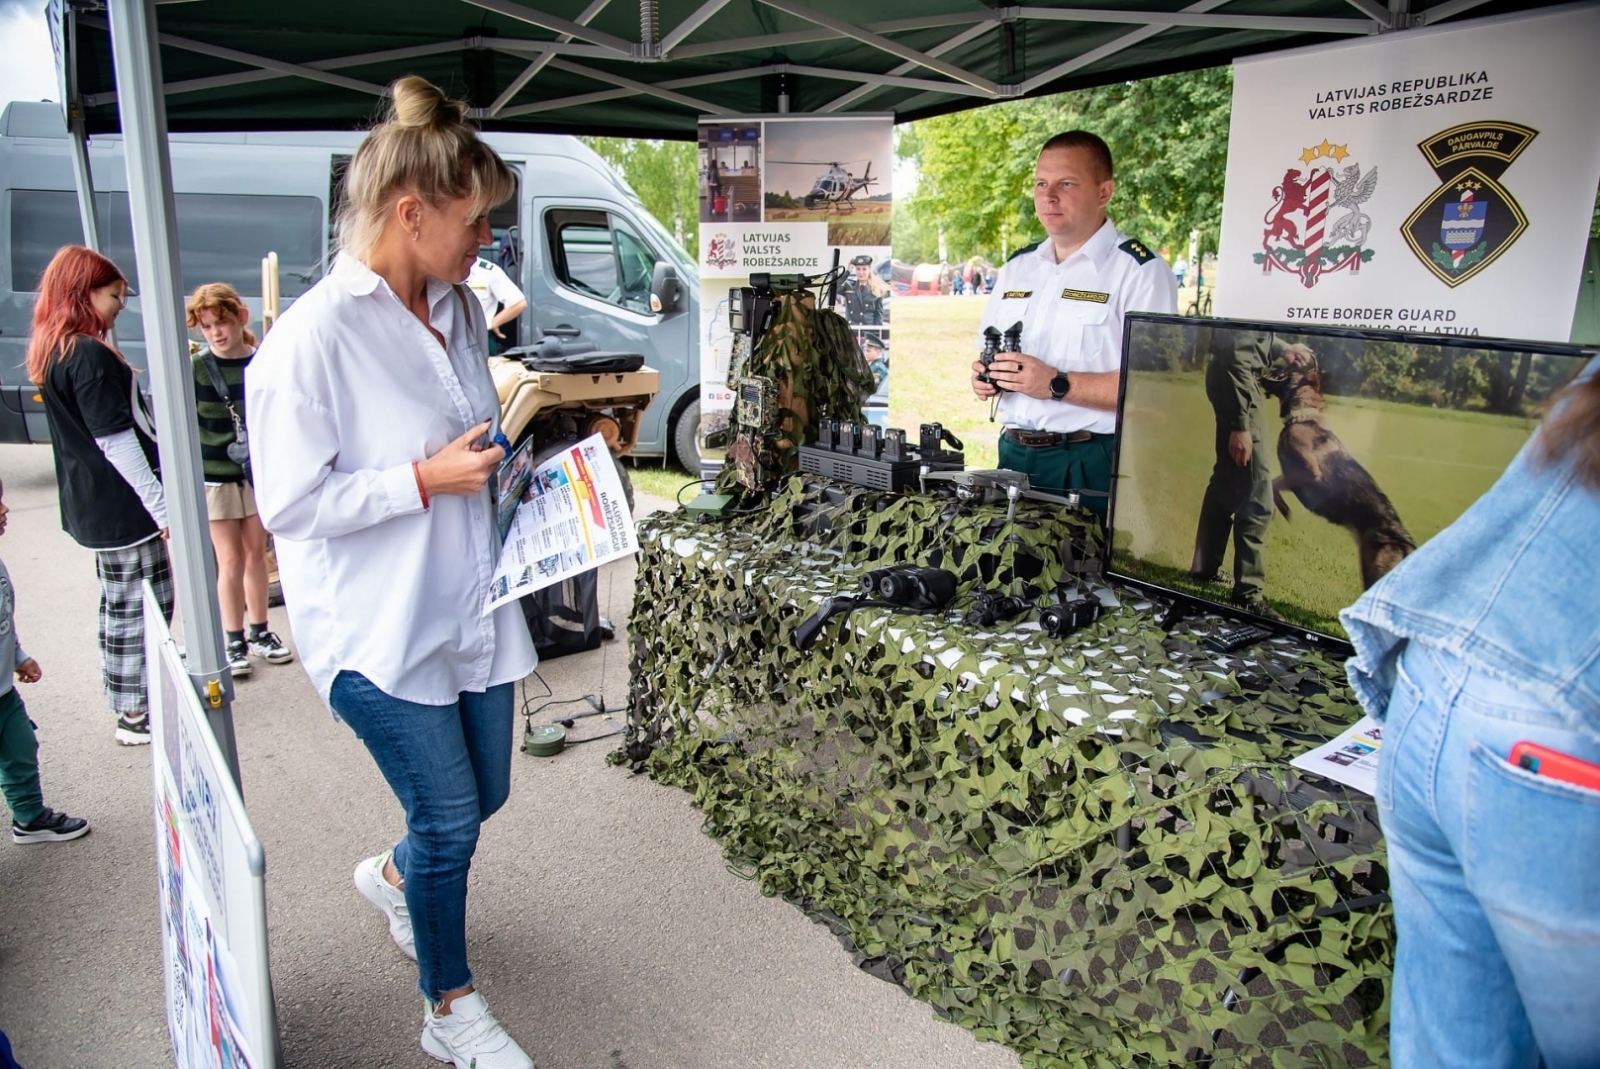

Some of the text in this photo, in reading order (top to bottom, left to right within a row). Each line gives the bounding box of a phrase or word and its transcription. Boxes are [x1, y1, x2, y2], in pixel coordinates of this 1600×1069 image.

[1316, 70, 1489, 104] LATVIJAS REPUBLIKA
[1308, 86, 1494, 120] VALSTS ROBEŽSARDZE
[1447, 132, 1504, 147] DAUGAVPILS
[1452, 141, 1499, 153] PĀRVALDE
[743, 233, 791, 243] LATVIJAS
[743, 245, 781, 255] VALSTS
[743, 256, 818, 267] ROBEŽSARDZE
[1286, 307, 1456, 322] STATE BORDER GUARD
[620, 531, 629, 549] PAR
